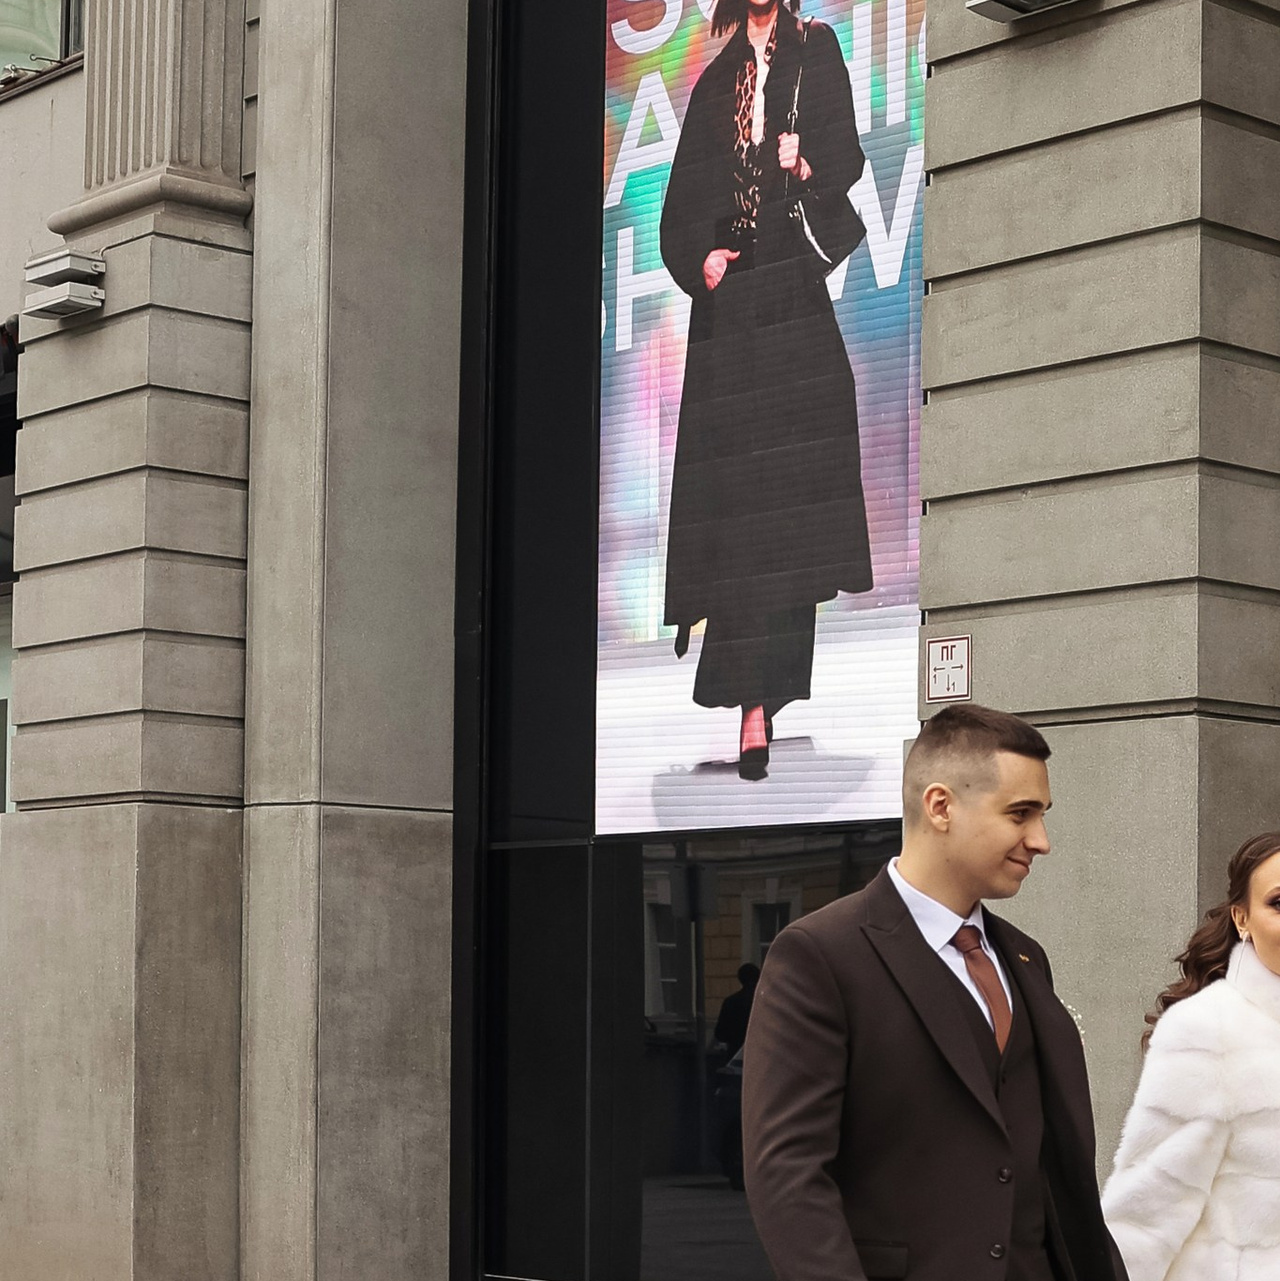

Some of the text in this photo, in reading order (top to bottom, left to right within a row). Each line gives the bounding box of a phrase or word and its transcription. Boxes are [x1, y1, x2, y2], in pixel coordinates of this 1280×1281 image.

[941, 645, 956, 661] ПГ
[933, 674, 937, 684] 1
[951, 682, 956, 692] 1
